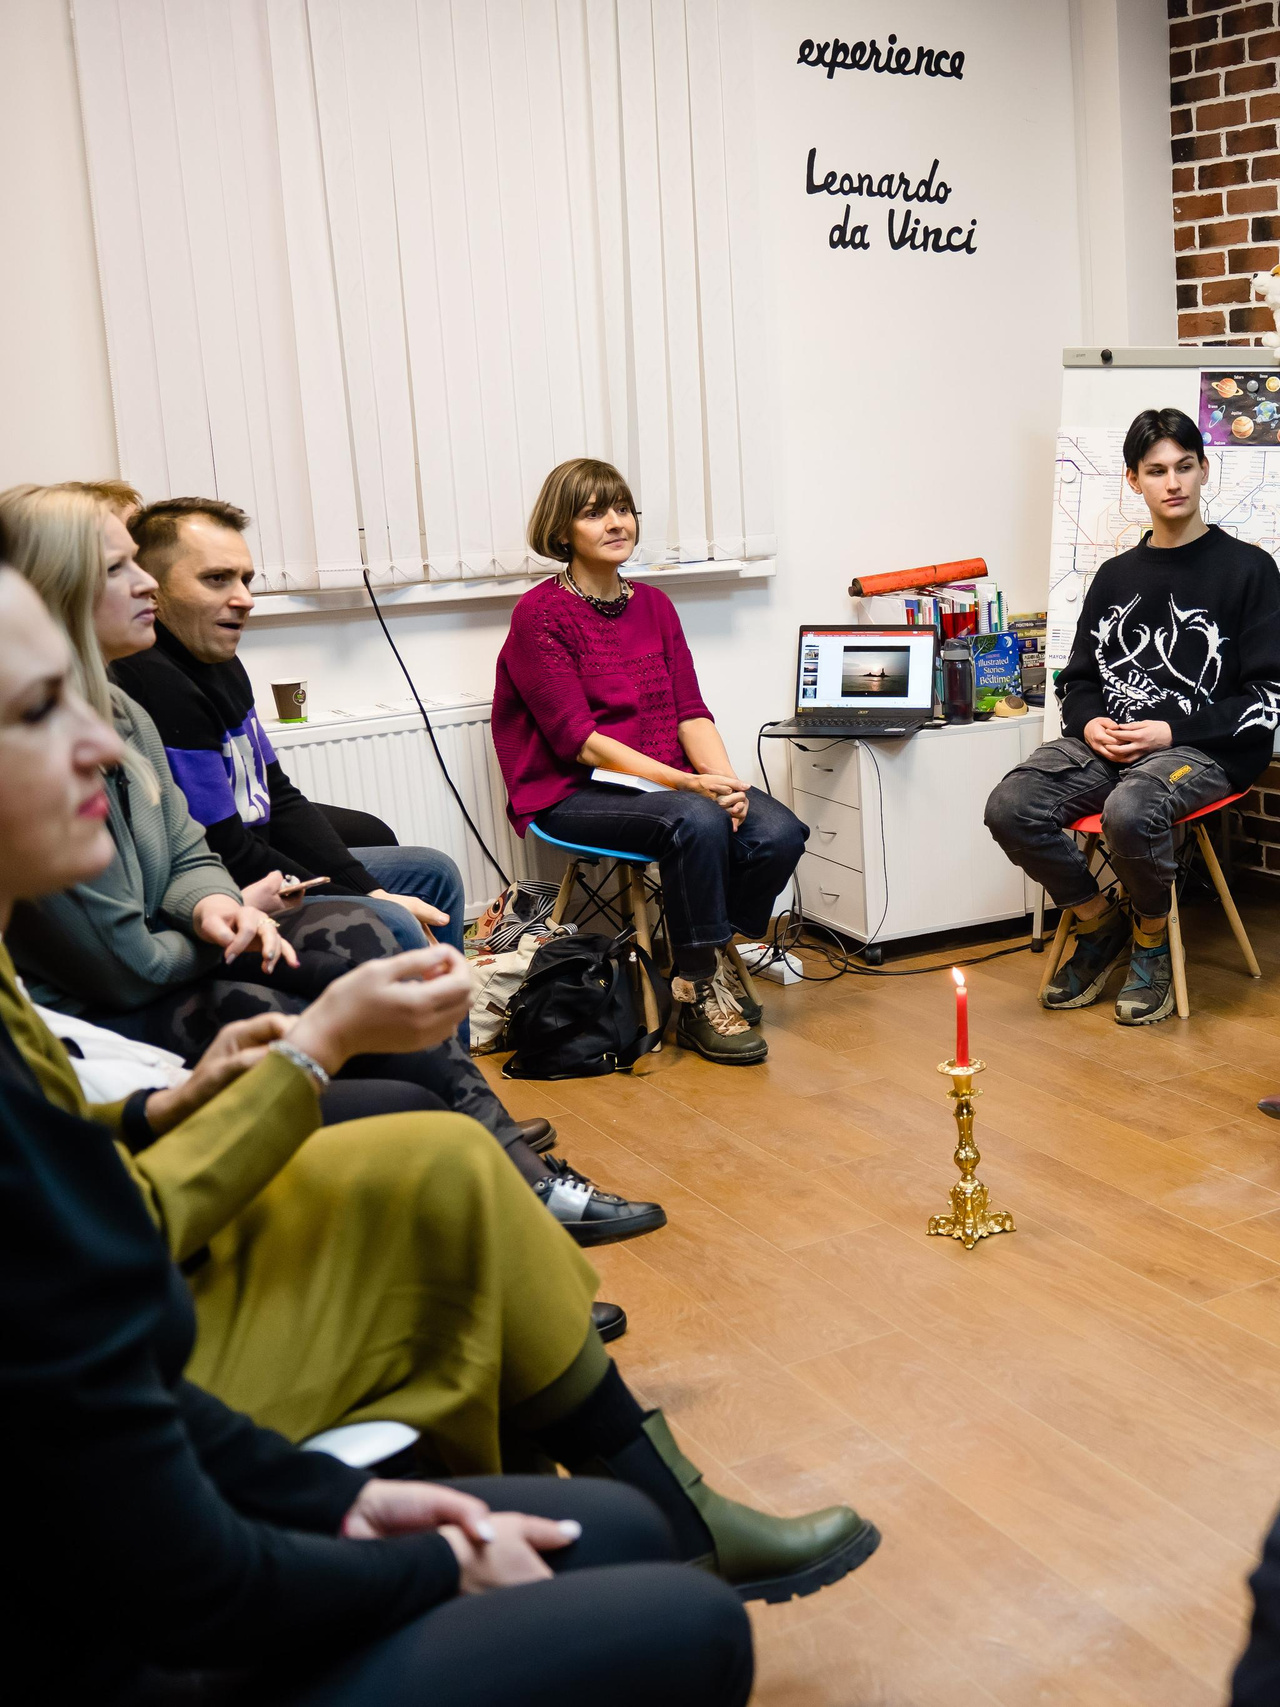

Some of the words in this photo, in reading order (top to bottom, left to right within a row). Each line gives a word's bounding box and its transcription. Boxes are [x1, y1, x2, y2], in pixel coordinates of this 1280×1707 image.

[797, 34, 965, 80] experience
[806, 147, 952, 204] Leonardo
[829, 204, 870, 250] da
[888, 208, 977, 255] Vinci
[978, 656, 1009, 667] Illustrated
[980, 675, 1011, 685] Bedtime
